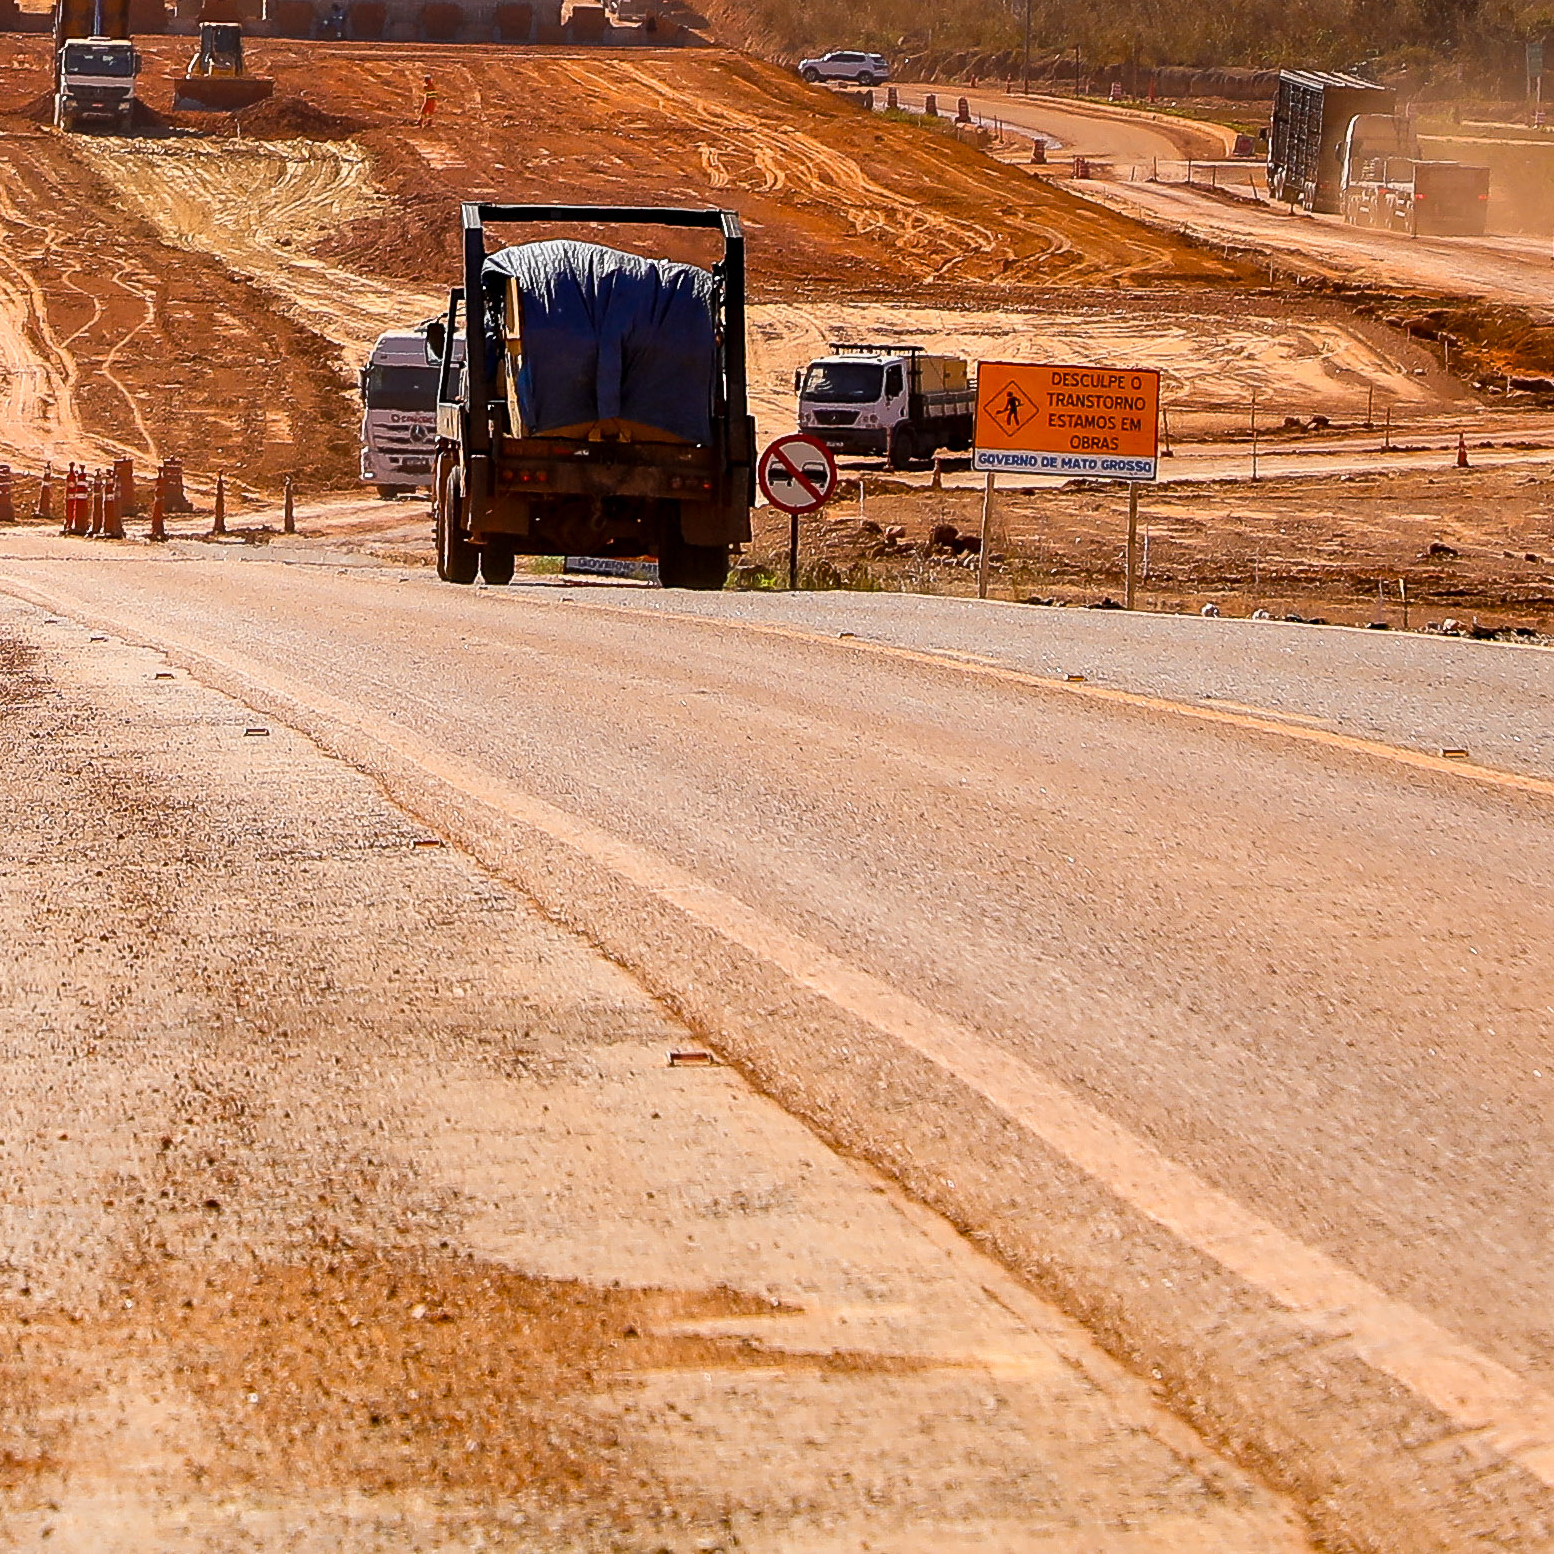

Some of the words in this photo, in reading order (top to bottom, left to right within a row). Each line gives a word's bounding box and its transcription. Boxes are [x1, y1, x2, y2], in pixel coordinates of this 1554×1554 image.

[1051, 371, 1125, 389] DESCULPE
[1131, 376, 1142, 390] O
[1046, 392, 1146, 411] TRANSTORNO
[1048, 413, 1116, 431] ESTAMOS
[1121, 417, 1142, 432] EM
[1070, 435, 1119, 451] OBRAS
[978, 453, 1038, 467] GOVERNO
[1041, 456, 1057, 468] DE
[1061, 457, 1097, 470] MATO
[1101, 459, 1152, 473] GROSSO
